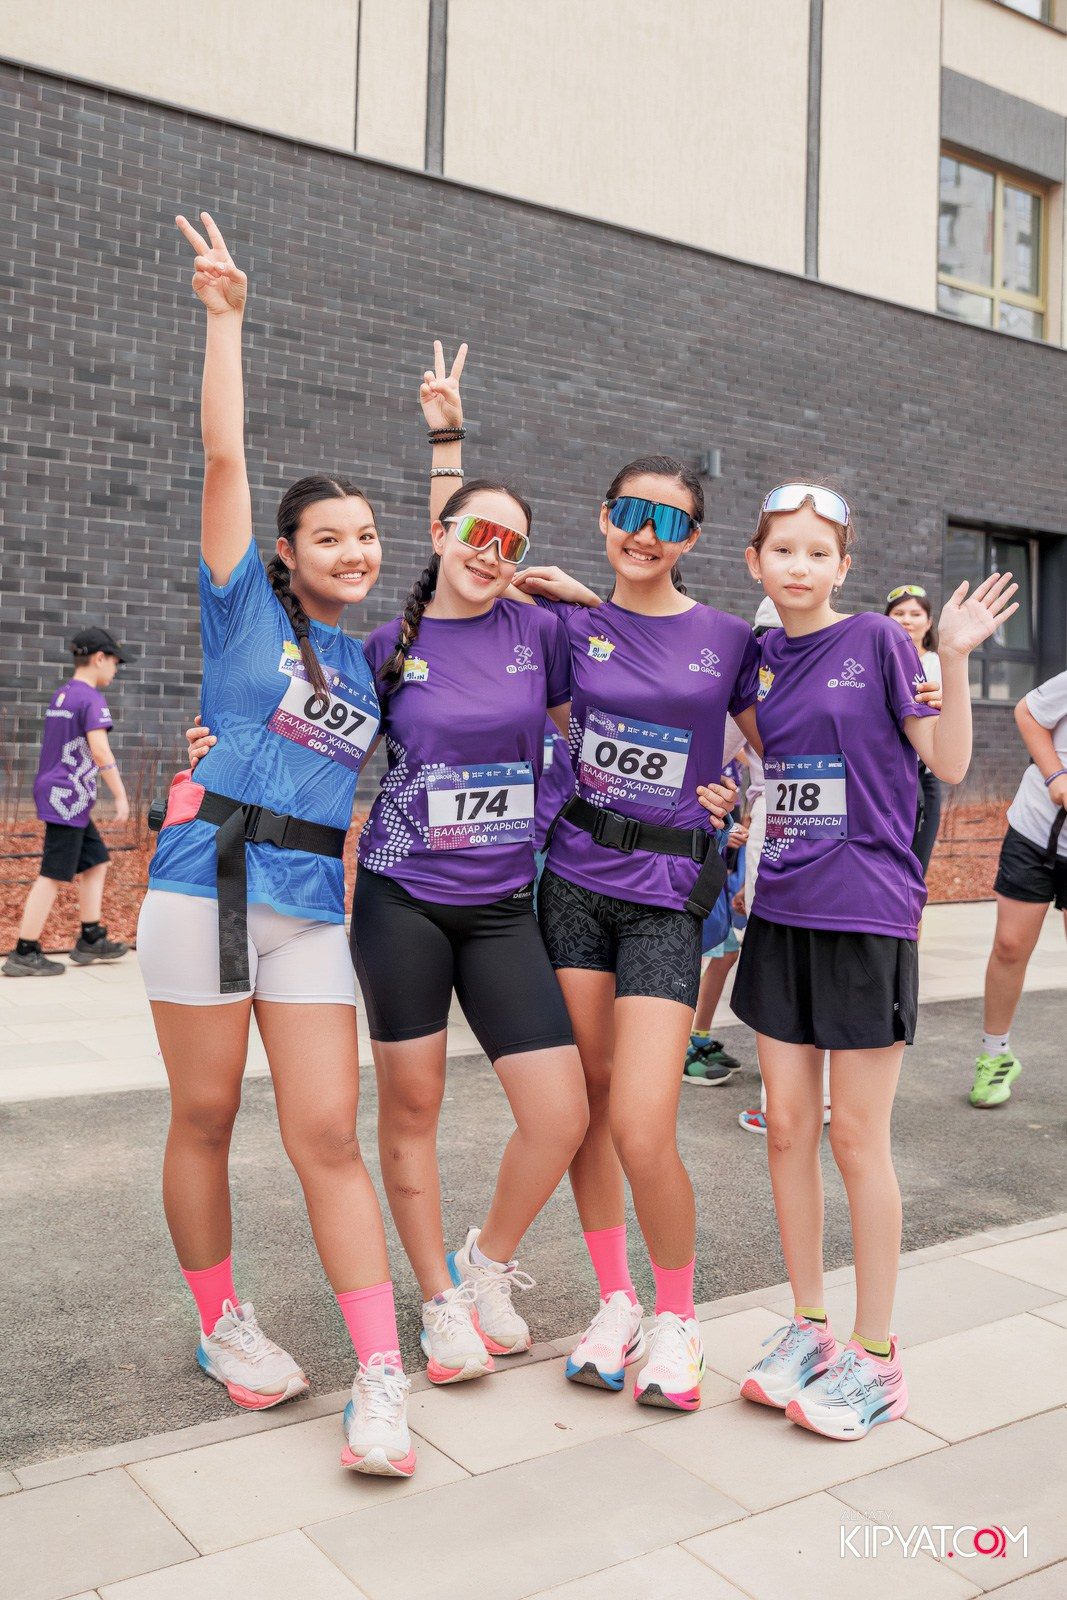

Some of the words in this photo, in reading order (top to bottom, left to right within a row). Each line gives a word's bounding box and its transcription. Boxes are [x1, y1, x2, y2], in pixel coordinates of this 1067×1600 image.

[518, 663, 538, 672] GROUP
[701, 667, 722, 678] GROUP
[839, 680, 865, 689] GROUP
[304, 693, 367, 736] 097
[277, 713, 326, 739] БАЛАЛАР
[326, 735, 363, 760] ЖАРЫСЫ
[308, 739, 328, 754] 600
[595, 741, 668, 780] 068
[583, 764, 622, 784] БАЛАЛАР
[624, 780, 676, 798] ЖАРЫСЫ
[607, 785, 627, 798] 600
[776, 783, 820, 811] 218
[455, 789, 508, 821] 174
[434, 825, 480, 837] БАЛАЛАР
[482, 820, 529, 832] ЖАРЫСЫ
[767, 816, 792, 825] БАЛАЛАР
[793, 817, 842, 826] ЖАРЫСЫ
[469, 834, 488, 844] 600
[783, 828, 798, 836] 600
